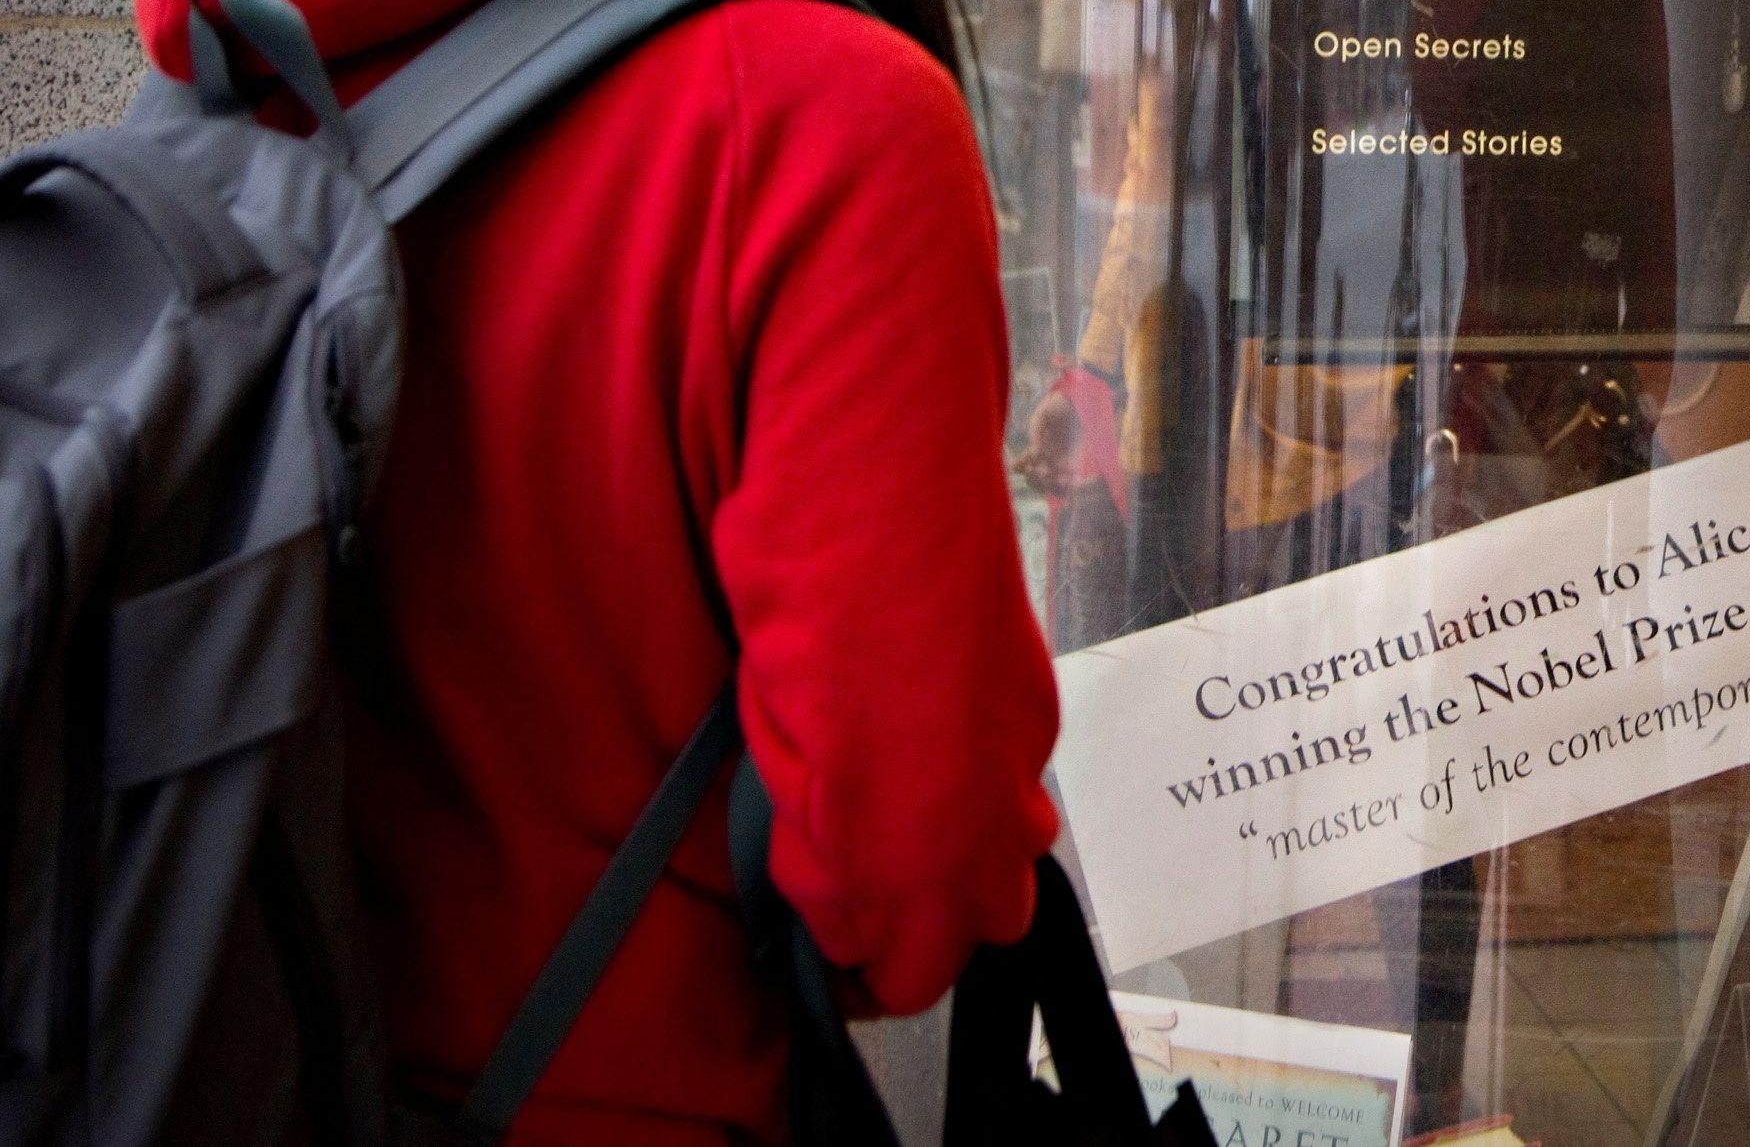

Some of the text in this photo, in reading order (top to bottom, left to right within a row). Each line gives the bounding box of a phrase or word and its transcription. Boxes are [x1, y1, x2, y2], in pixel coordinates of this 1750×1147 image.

[1314, 32, 1525, 62] Open Secrets
[1312, 129, 1562, 157] Selected Stories
[1195, 579, 1580, 721] Congratulations
[1594, 561, 1640, 596] to
[1166, 724, 1372, 810] winning
[1384, 695, 1461, 742] the
[1466, 630, 1617, 716] Nobel
[1623, 603, 1747, 665] Prize
[1239, 794, 1403, 861] “master
[1420, 759, 1455, 813] of
[1472, 745, 1533, 793] the
[1281, 1098, 1364, 1125] WELCOME
